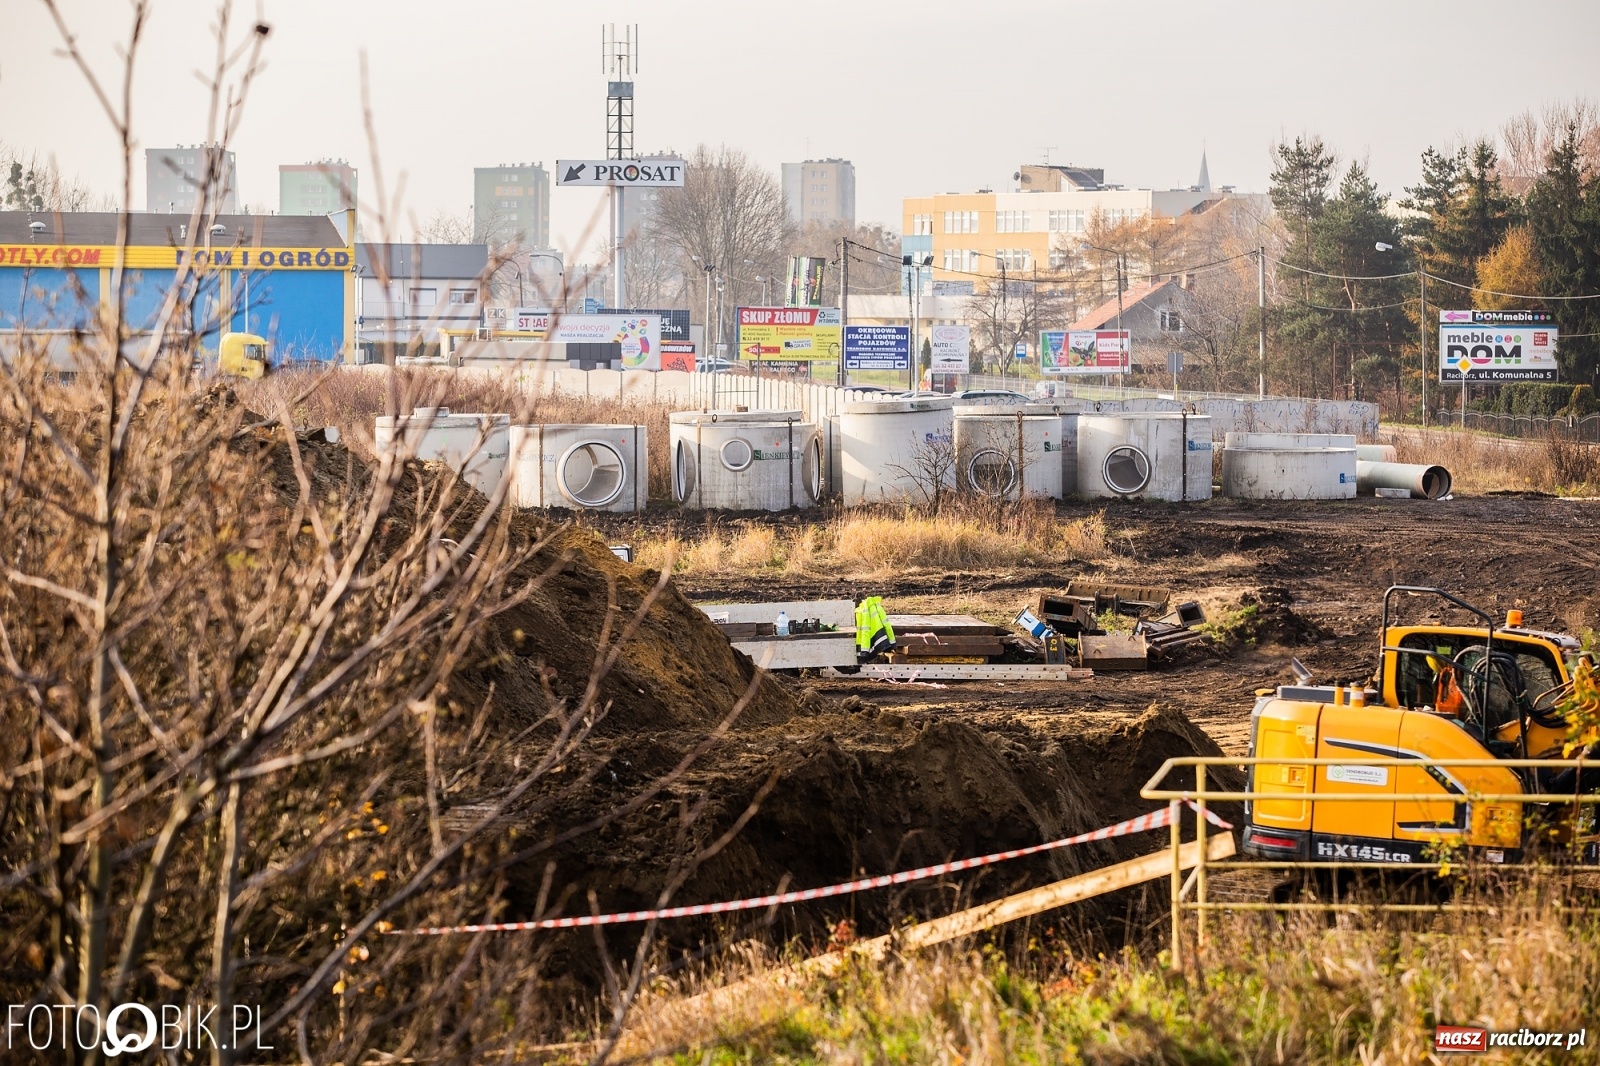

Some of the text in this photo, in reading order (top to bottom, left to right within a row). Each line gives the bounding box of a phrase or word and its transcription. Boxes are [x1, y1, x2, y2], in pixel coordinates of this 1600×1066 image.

[594, 164, 680, 182] PROSAT
[259, 248, 350, 267] OGRÓD
[742, 311, 811, 324] SKUP ZŁOMU
[579, 323, 610, 333] decyzja
[1447, 332, 1494, 344] meble
[1447, 345, 1522, 365] DOM
[1478, 371, 1491, 379] ul.
[1492, 371, 1544, 379] Komunalna
[1545, 371, 1552, 379] 5
[754, 450, 801, 461] SIENKIEWCZ
[1317, 842, 1412, 863] HX145LCR
